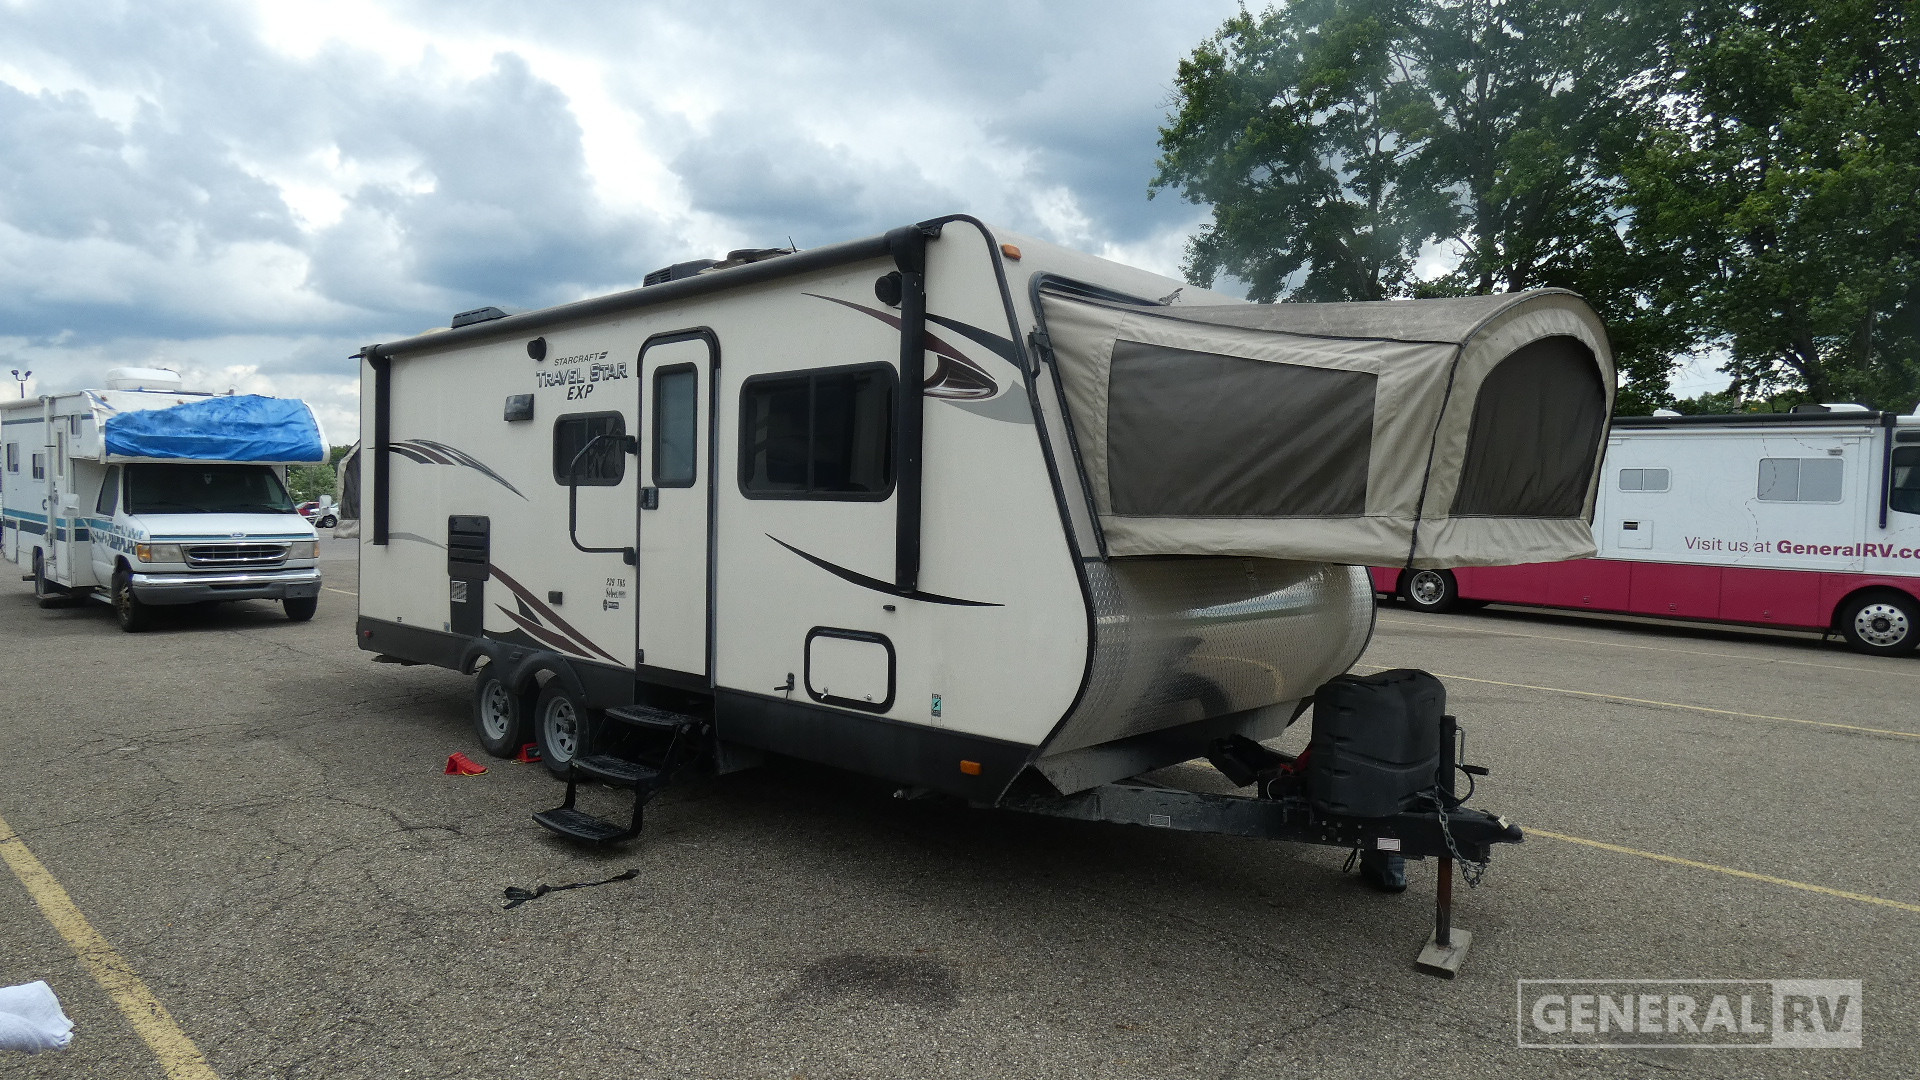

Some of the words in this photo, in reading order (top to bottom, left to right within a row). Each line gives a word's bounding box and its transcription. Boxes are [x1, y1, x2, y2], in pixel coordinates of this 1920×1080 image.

[554, 352, 599, 366] STARCRAFT
[536, 367, 585, 388] TRAVEL
[589, 362, 628, 382] STAR
[566, 384, 594, 400] EXP
[1684, 536, 1722, 551] Visit
[1728, 540, 1748, 552] us
[1755, 540, 1771, 553] at
